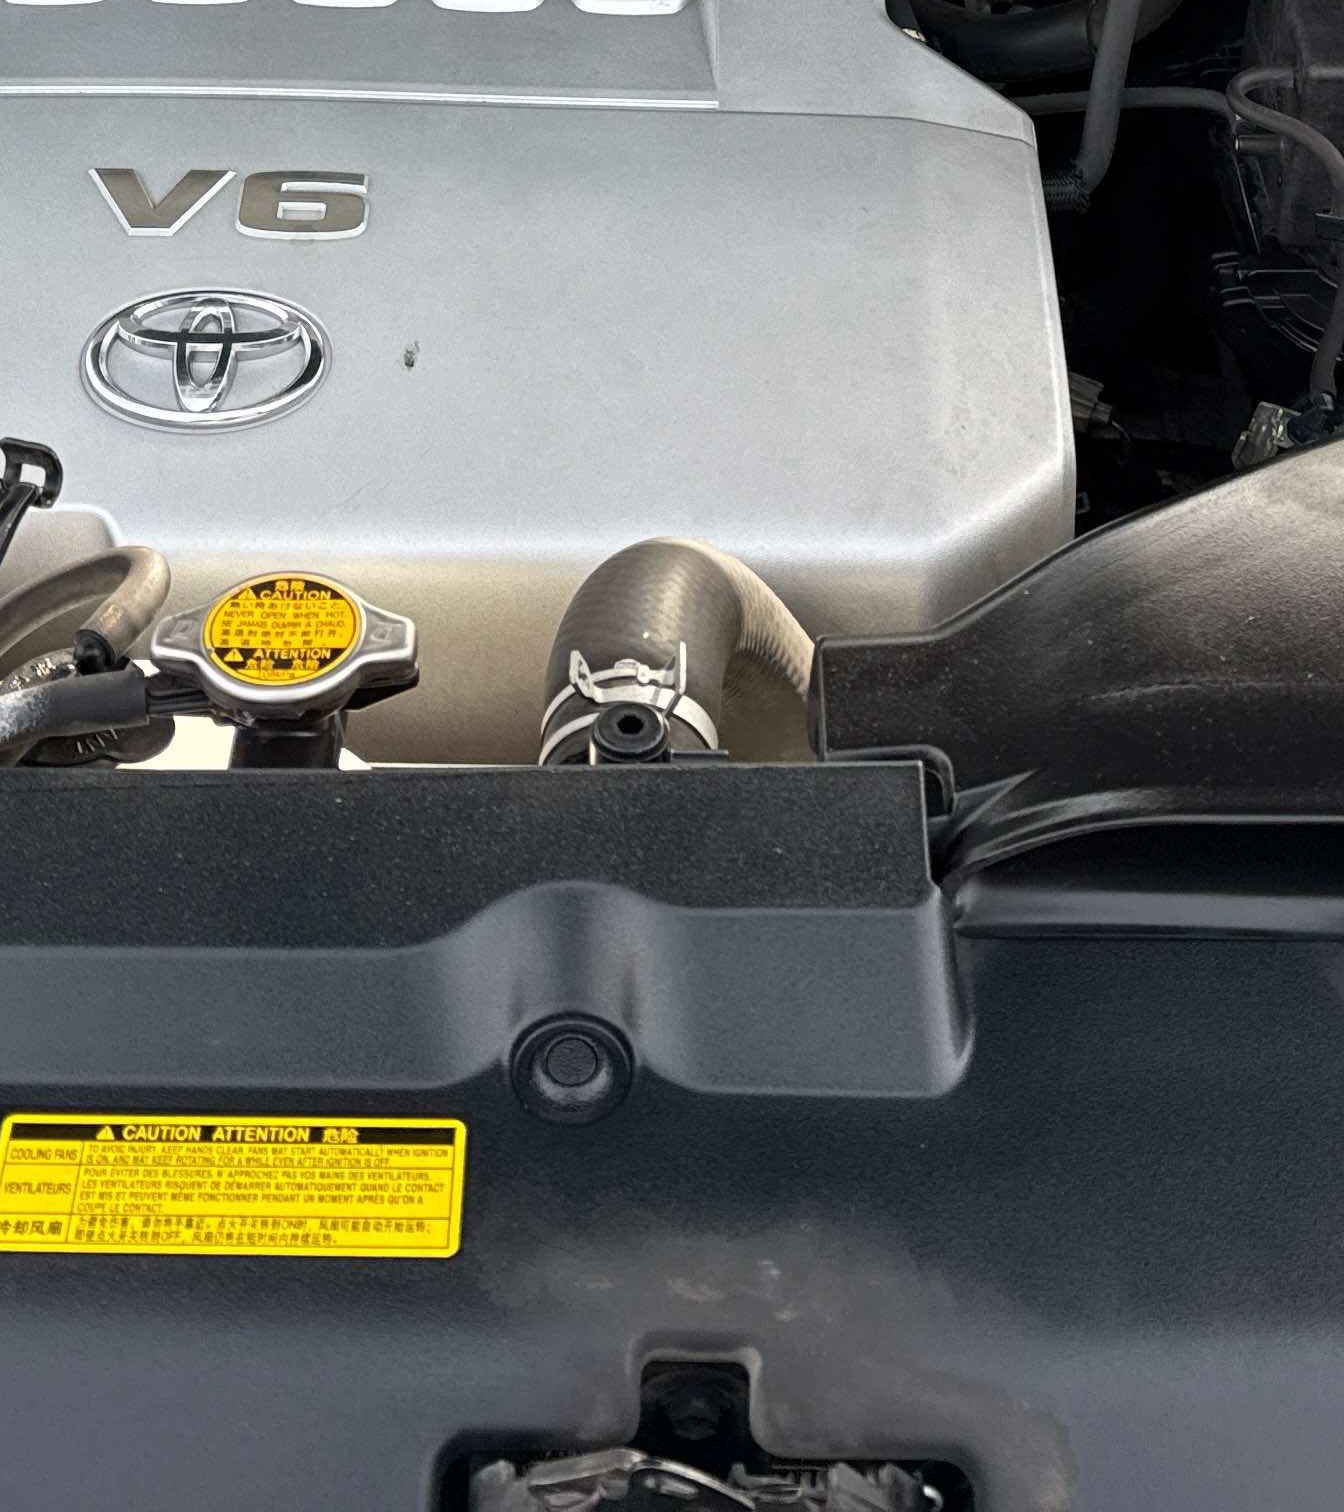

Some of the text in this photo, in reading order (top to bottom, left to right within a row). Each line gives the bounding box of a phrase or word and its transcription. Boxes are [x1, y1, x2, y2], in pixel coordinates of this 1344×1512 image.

[88, 167, 370, 239] V6
[259, 590, 332, 601] CAUTION
[223, 610, 255, 618] NEVER
[260, 611, 287, 620] OPEN
[293, 611, 320, 620] WHEN
[252, 648, 332, 660] ATTENTION
[122, 1125, 311, 1143] CAUTION ATTENTION
[10, 1148, 78, 1161] COOLING FANS
[290, 1146, 314, 1157] START
[386, 1148, 410, 1158] WHEN
[84, 1168, 106, 1178] POUR
[142, 1168, 159, 1179] DES
[282, 1171, 298, 1181] PAS
[319, 1171, 346, 1182] MAINS
[348, 1171, 366, 1182] DES
[7, 1182, 72, 1195] VENTILATEURS
[82, 1179, 98, 1190] LES
[100, 1179, 161, 1191] VENTILATEURS
[210, 1181, 222, 1191] DE
[274, 1182, 357, 1194] AUTOMATIQUEMENT
[359, 1182, 389, 1193] QUAND
[392, 1183, 403, 1193] LE
[405, 1183, 445, 1194] CONTACT
[115, 1191, 127, 1201] ET
[129, 1191, 167, 1202] PEUVENT
[197, 1192, 259, 1204] FONCTIONNER
[261, 1193, 301, 1204] PENDANT
[317, 1194, 355, 1205] MOMENT
[108, 1203, 120, 1213] LE
